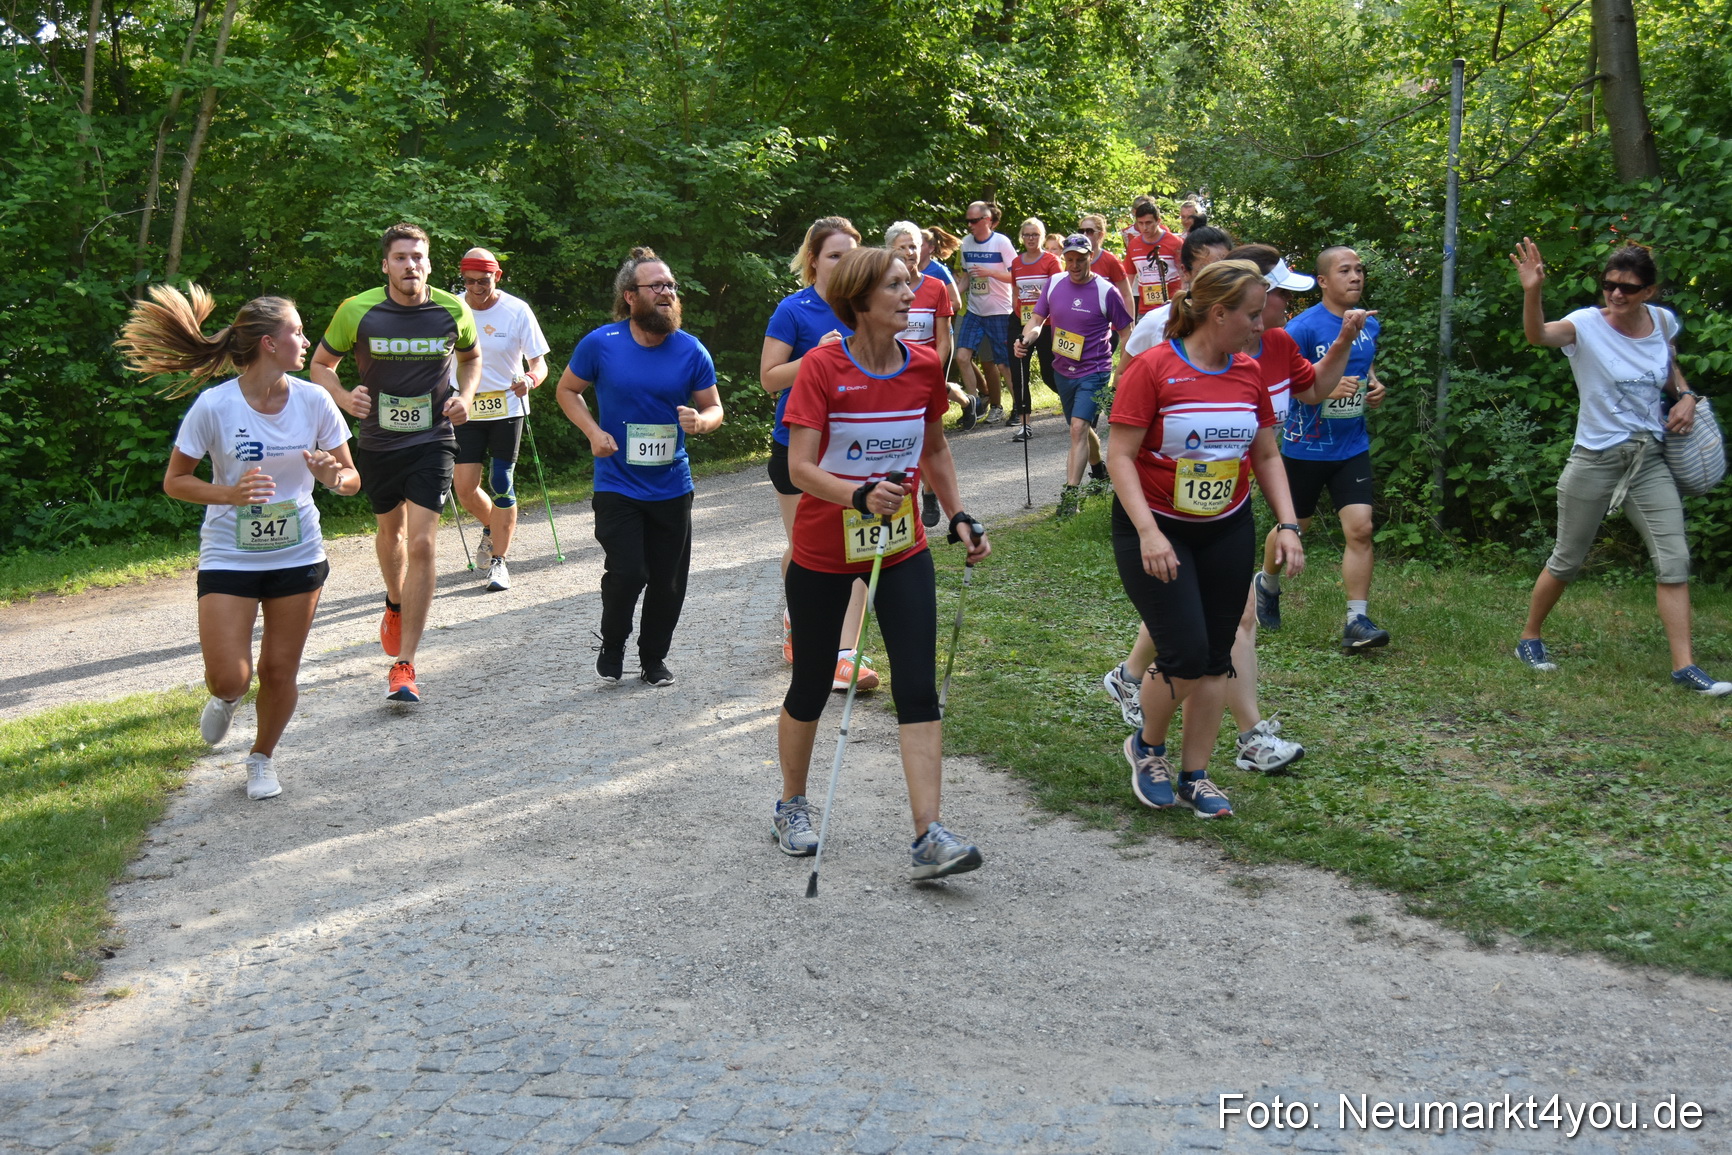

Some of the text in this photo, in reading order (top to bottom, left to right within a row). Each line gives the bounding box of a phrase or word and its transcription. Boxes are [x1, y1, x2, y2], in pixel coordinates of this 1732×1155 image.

[370, 339, 447, 353] BOCK
[1057, 338, 1076, 352] 902
[472, 398, 502, 411] 1338
[1327, 393, 1363, 408] 2042
[390, 408, 420, 422] 298
[1204, 427, 1255, 442] Petry
[639, 442, 666, 456] 9111
[866, 436, 918, 450] Petry
[1184, 479, 1233, 500] 1828
[250, 518, 288, 538] 347
[855, 516, 907, 546] 1814
